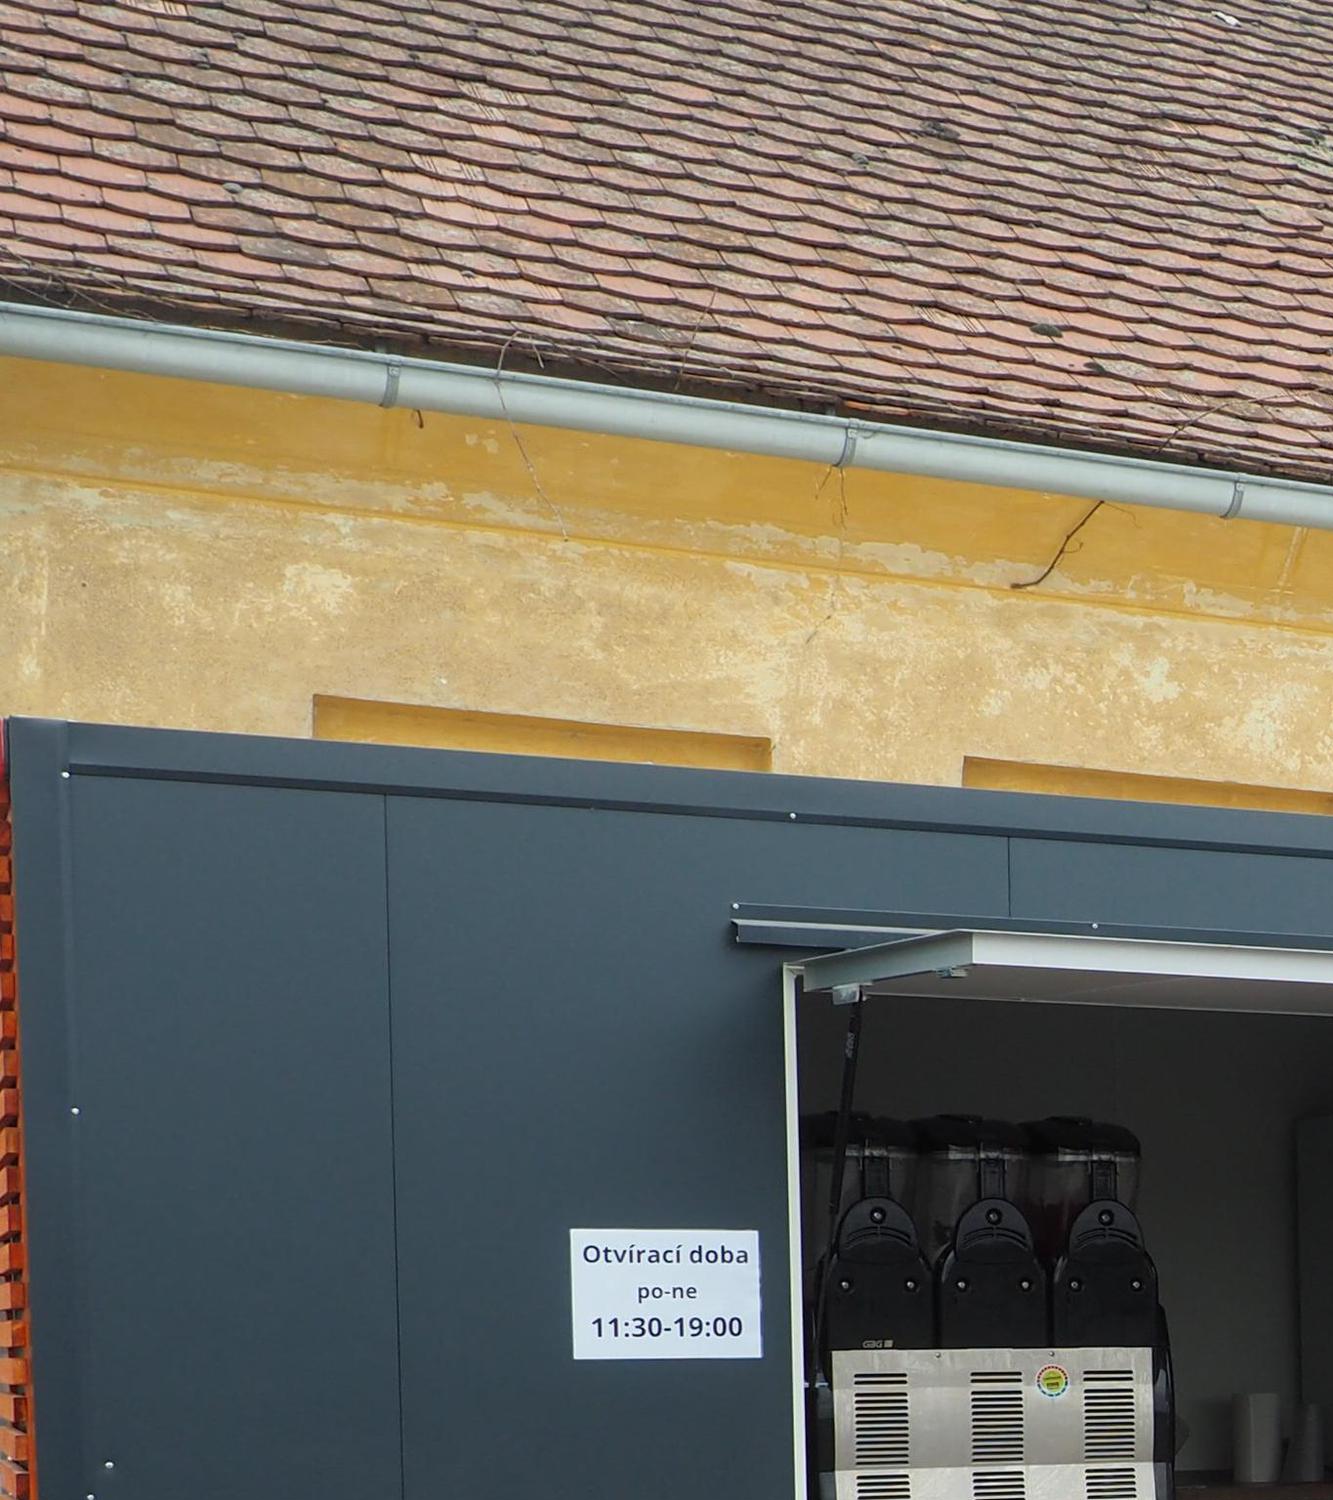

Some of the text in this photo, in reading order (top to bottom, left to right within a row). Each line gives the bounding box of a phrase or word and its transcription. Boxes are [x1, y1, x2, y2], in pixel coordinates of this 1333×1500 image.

[582, 1244, 749, 1265] Otvírací doba
[638, 1286, 698, 1304] po-ne
[591, 1316, 743, 1338] 11:30-19:00
